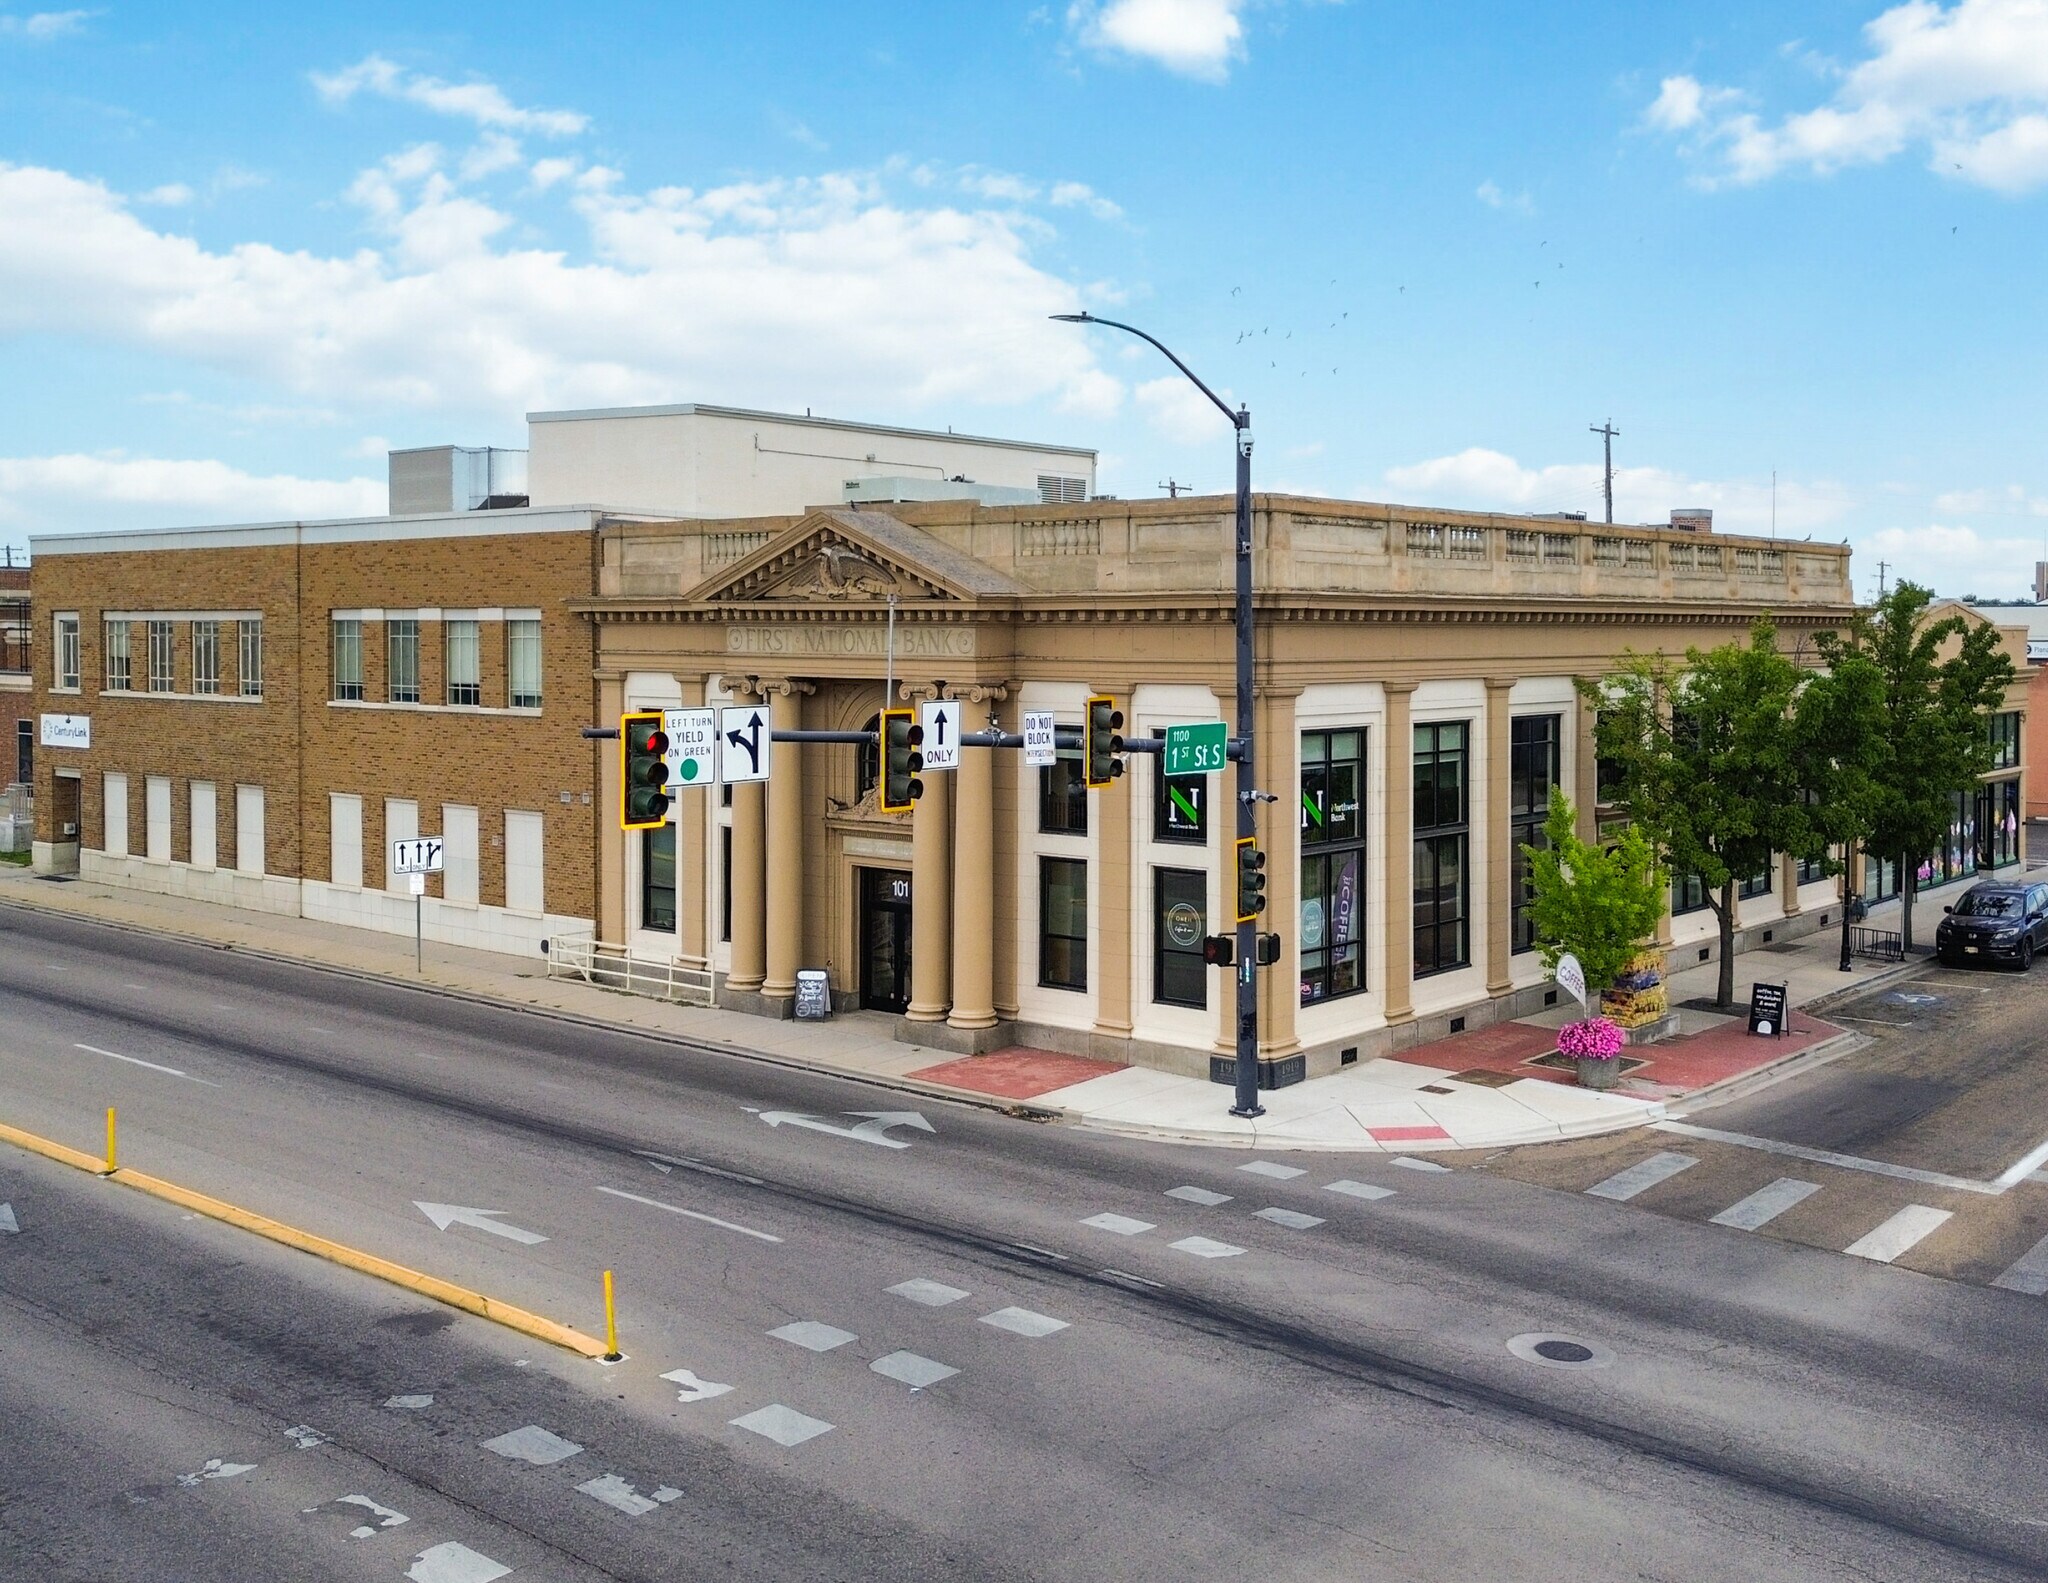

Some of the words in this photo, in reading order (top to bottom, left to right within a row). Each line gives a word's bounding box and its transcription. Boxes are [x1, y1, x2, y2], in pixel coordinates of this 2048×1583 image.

[745, 628, 793, 652] FIRST
[803, 629, 890, 653] NATIONAL
[903, 630, 953, 653] BANK
[666, 718, 687, 728] LEFT
[691, 717, 712, 727] TURN
[1025, 718, 1036, 730] DO
[1039, 717, 1052, 730] NOT
[53, 725, 88, 739] CenturyLink
[676, 731, 704, 743] YIELD
[1173, 730, 1190, 742] 1100
[1027, 733, 1051, 744] BLOCK
[668, 748, 679, 757] ON
[684, 746, 711, 756] GREEN
[926, 749, 954, 763] ONLY
[1194, 744, 1209, 767] St
[1212, 743, 1221, 766] S
[1330, 801, 1360, 813] Northwest
[1330, 812, 1346, 822] Bank
[892, 880, 909, 897] 101
[1560, 966, 1584, 994] COFFEE
[1220, 1062, 1237, 1073] 191
